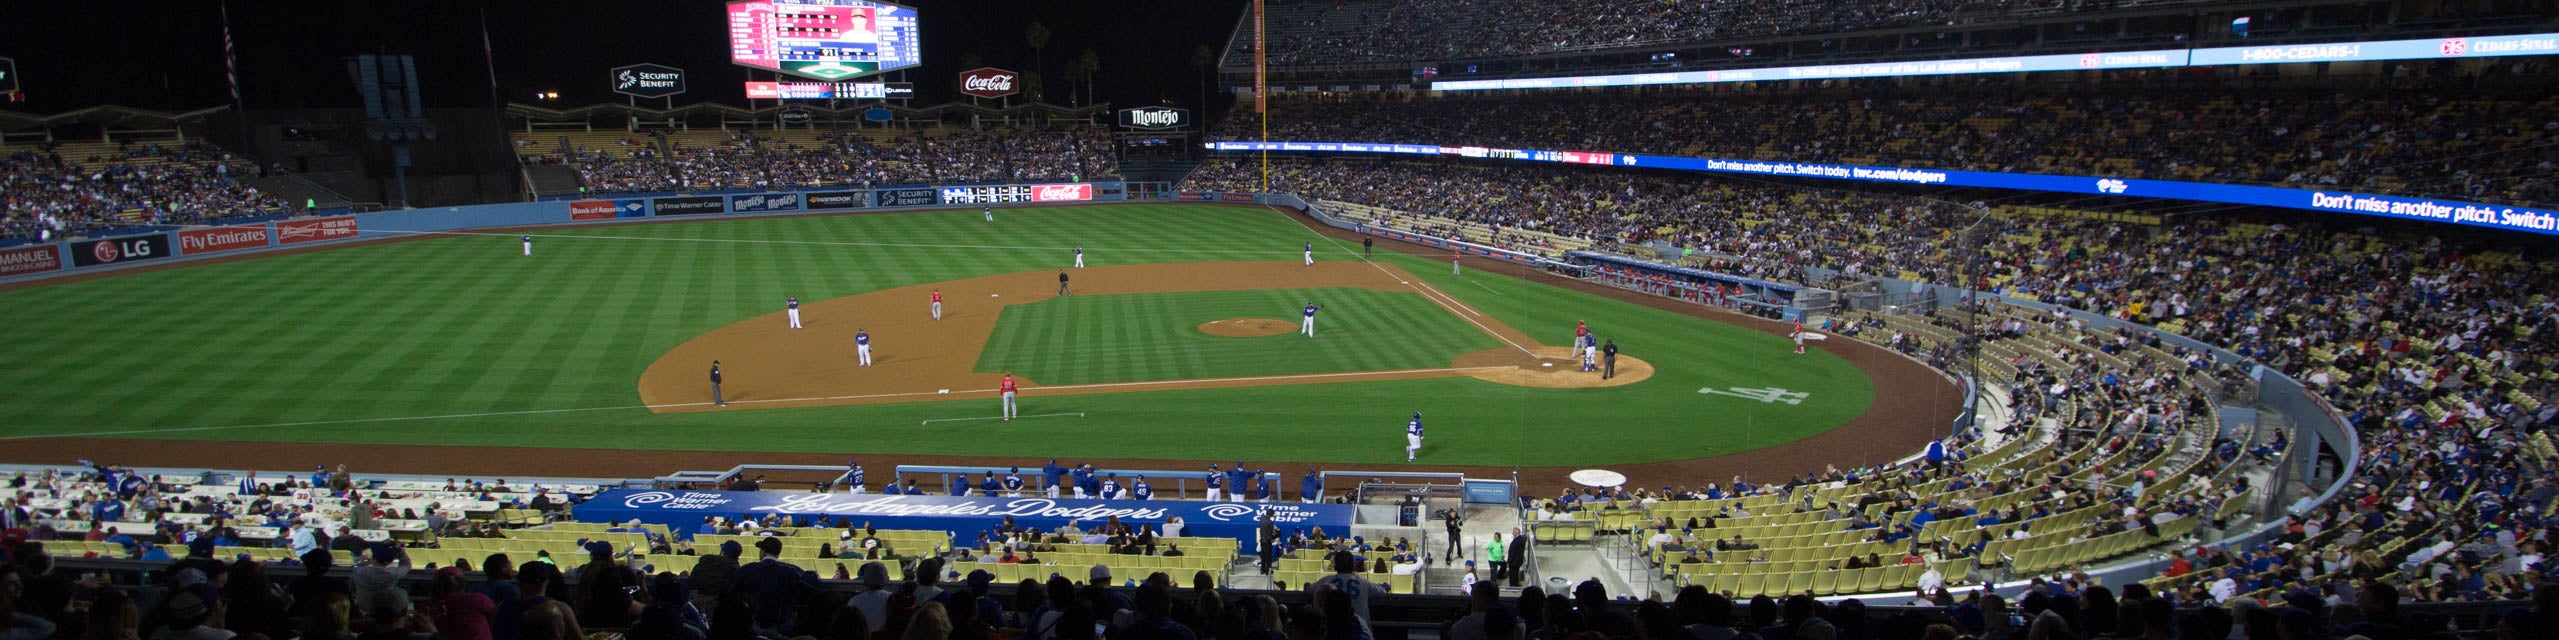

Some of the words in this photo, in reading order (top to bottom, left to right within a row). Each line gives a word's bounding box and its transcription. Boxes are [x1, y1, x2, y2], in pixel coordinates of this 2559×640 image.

[2242, 44, 2359, 60] 1-800-CEDARS-1
[1904, 63, 1918, 73] the
[640, 72, 679, 80] SECURITY
[640, 80, 675, 88] BENEFIT
[1132, 109, 1179, 126] Montejo
[1708, 159, 1726, 171] Don't
[1726, 162, 1744, 172] miss
[1744, 163, 1773, 174] another
[1773, 163, 1795, 176] pitch.
[1796, 164, 1824, 176] Switch
[1824, 166, 1850, 178] today.
[1853, 167, 1946, 184] twc.com/dodgers
[897, 190, 932, 198] SECURITY
[735, 195, 765, 212] Montejo
[767, 194, 796, 210] Montejo
[897, 197, 931, 205] BENEFIT
[572, 207, 590, 215] Bank
[598, 205, 627, 214] America
[2312, 192, 2353, 210] Don't
[2354, 197, 2390, 213] miss
[2391, 199, 2453, 219] another
[2453, 205, 2499, 224] pitch.
[2500, 208, 2555, 230] Switch
[181, 235, 205, 250] Fly
[206, 229, 266, 246] Emirates
[122, 239, 150, 258] LG
[0, 249, 54, 266] MANUEL
[1103, 484, 1114, 493] 83
[1137, 487, 1147, 496] 49
[683, 491, 722, 499] Time
[670, 497, 732, 505] Warner
[750, 493, 831, 514] Los
[827, 495, 998, 516] Angeles
[988, 498, 1168, 521] Dodgers
